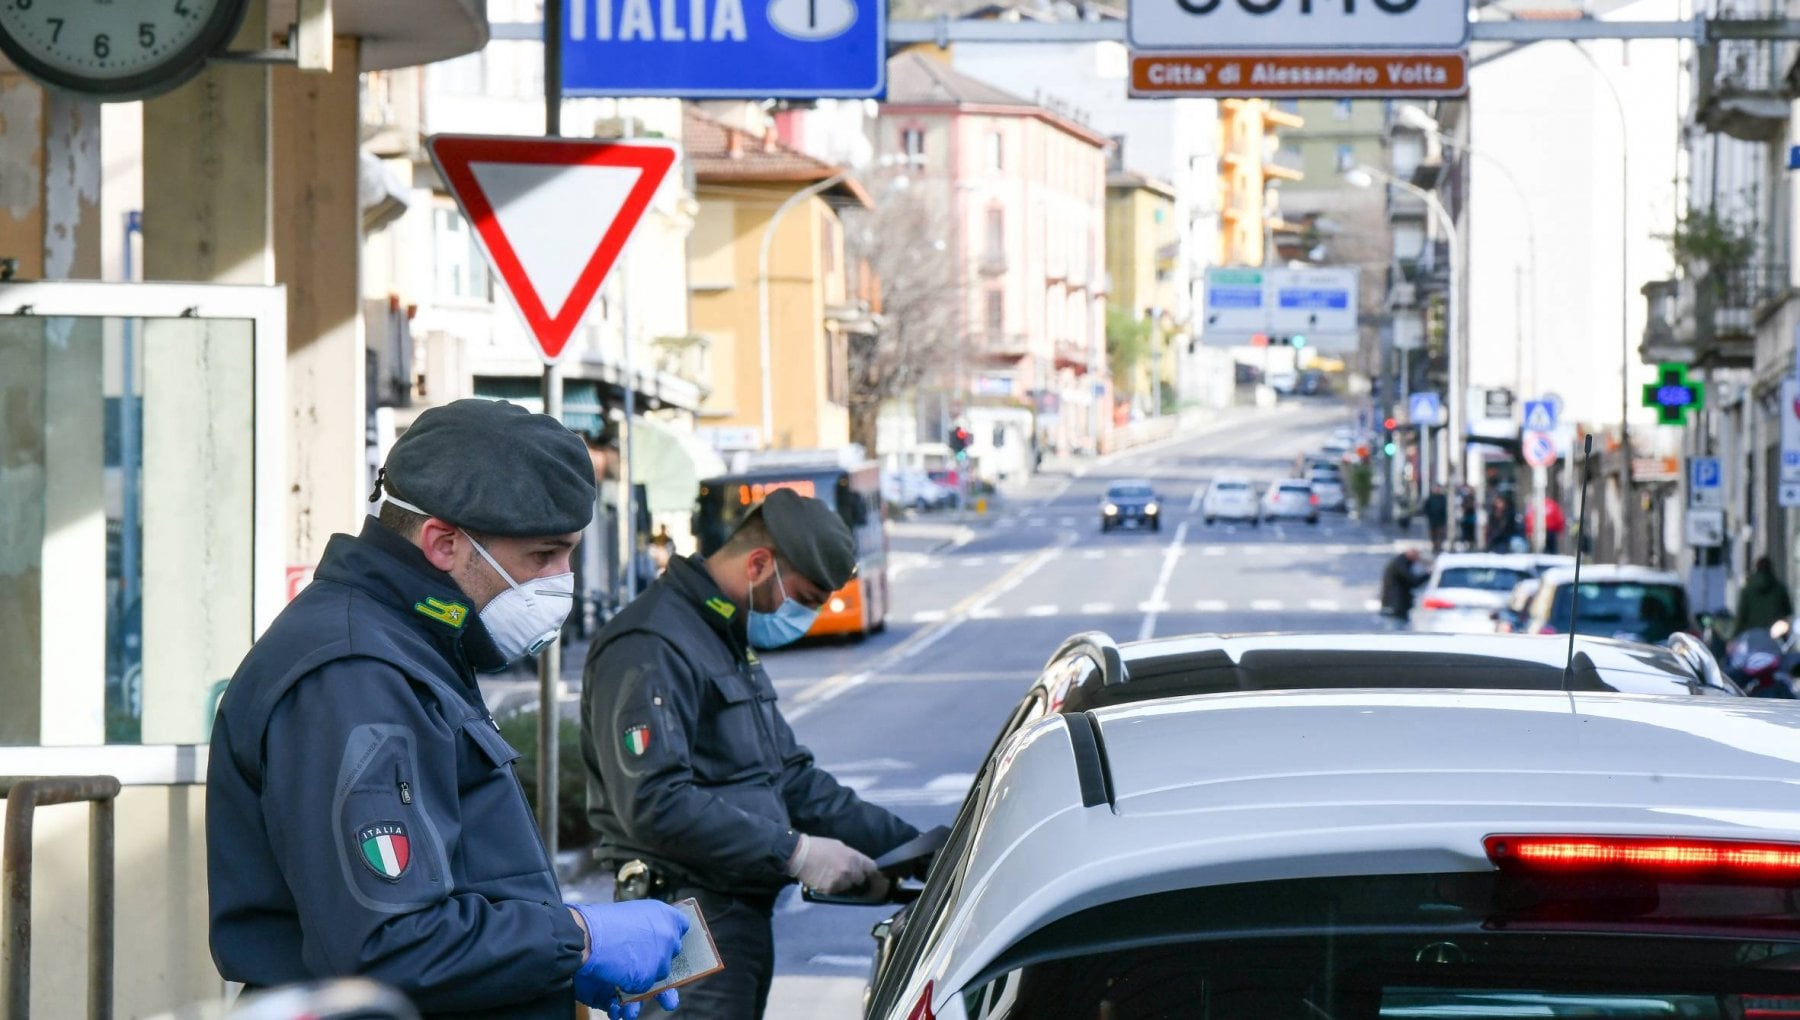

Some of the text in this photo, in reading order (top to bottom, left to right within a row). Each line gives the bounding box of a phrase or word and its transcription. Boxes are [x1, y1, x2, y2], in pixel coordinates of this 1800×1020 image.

[47, 18, 64, 44] 7
[139, 23, 155, 47] 5
[94, 34, 110, 58] 6
[1217, 63, 1241, 84] di
[1251, 63, 1379, 84] Alessandro
[1385, 63, 1448, 83] Volta
[363, 826, 402, 839] ITALIA
